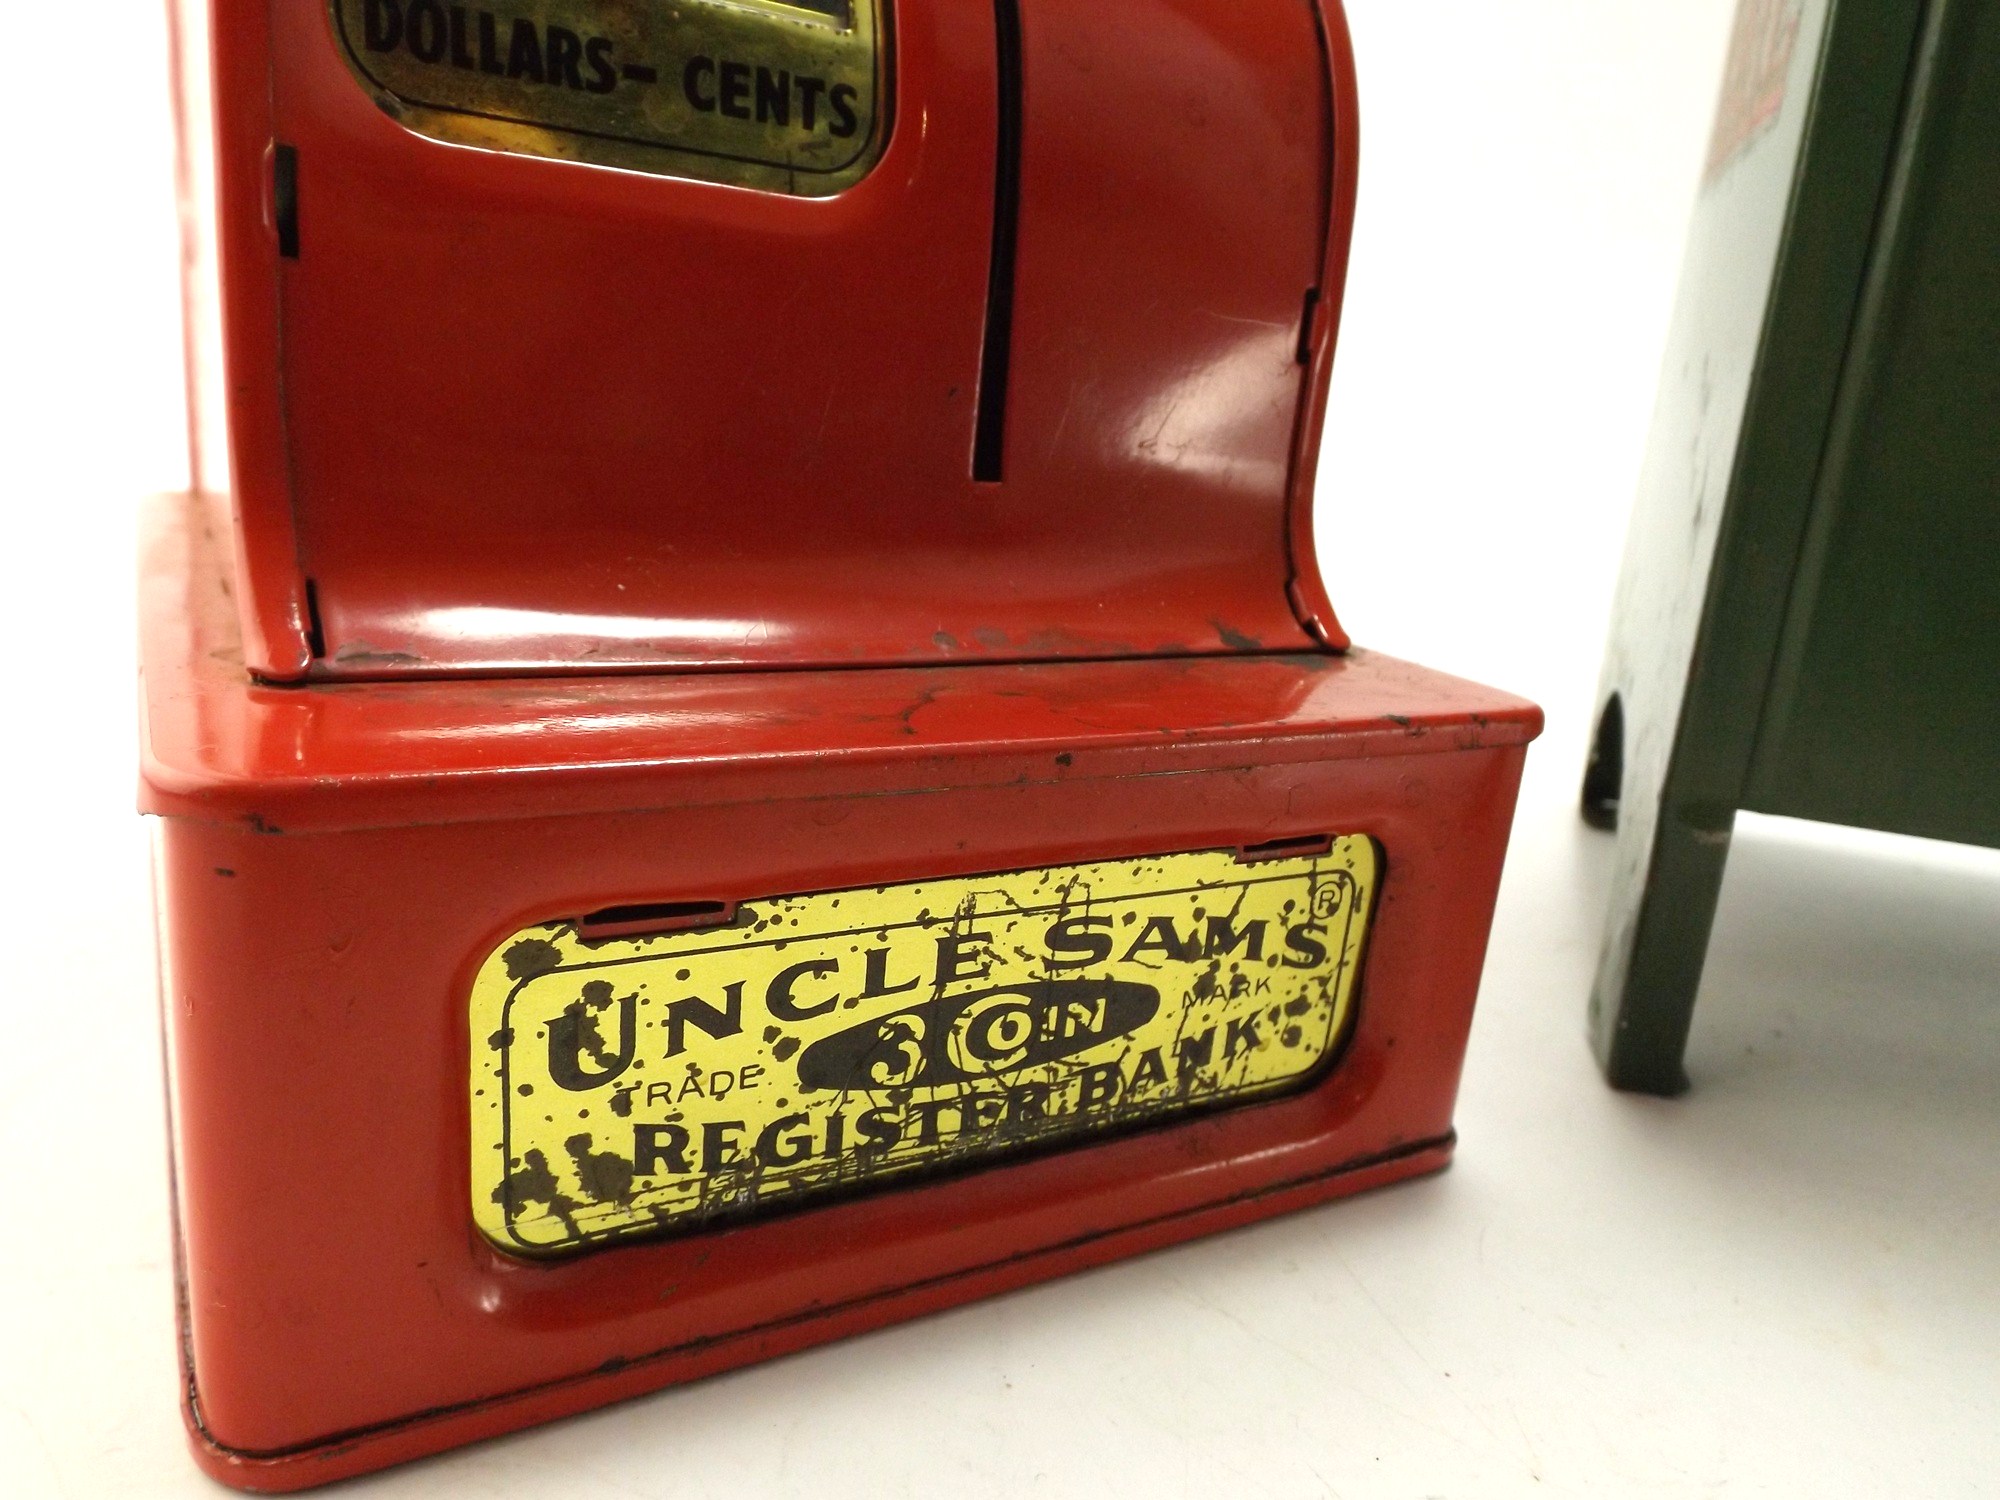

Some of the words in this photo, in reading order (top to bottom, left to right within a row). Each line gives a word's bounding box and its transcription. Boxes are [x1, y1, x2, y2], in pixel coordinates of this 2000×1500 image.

[683, 54, 858, 138] CENTS
[544, 934, 994, 1092] UNCLE
[1182, 976, 1271, 1010] MARK
[870, 1013, 926, 1085] 3
[946, 992, 1107, 1073] COIN
[614, 1063, 761, 1108] TRADE
[633, 1079, 1049, 1176] REGISTER
[1078, 1008, 1265, 1102] BANK
